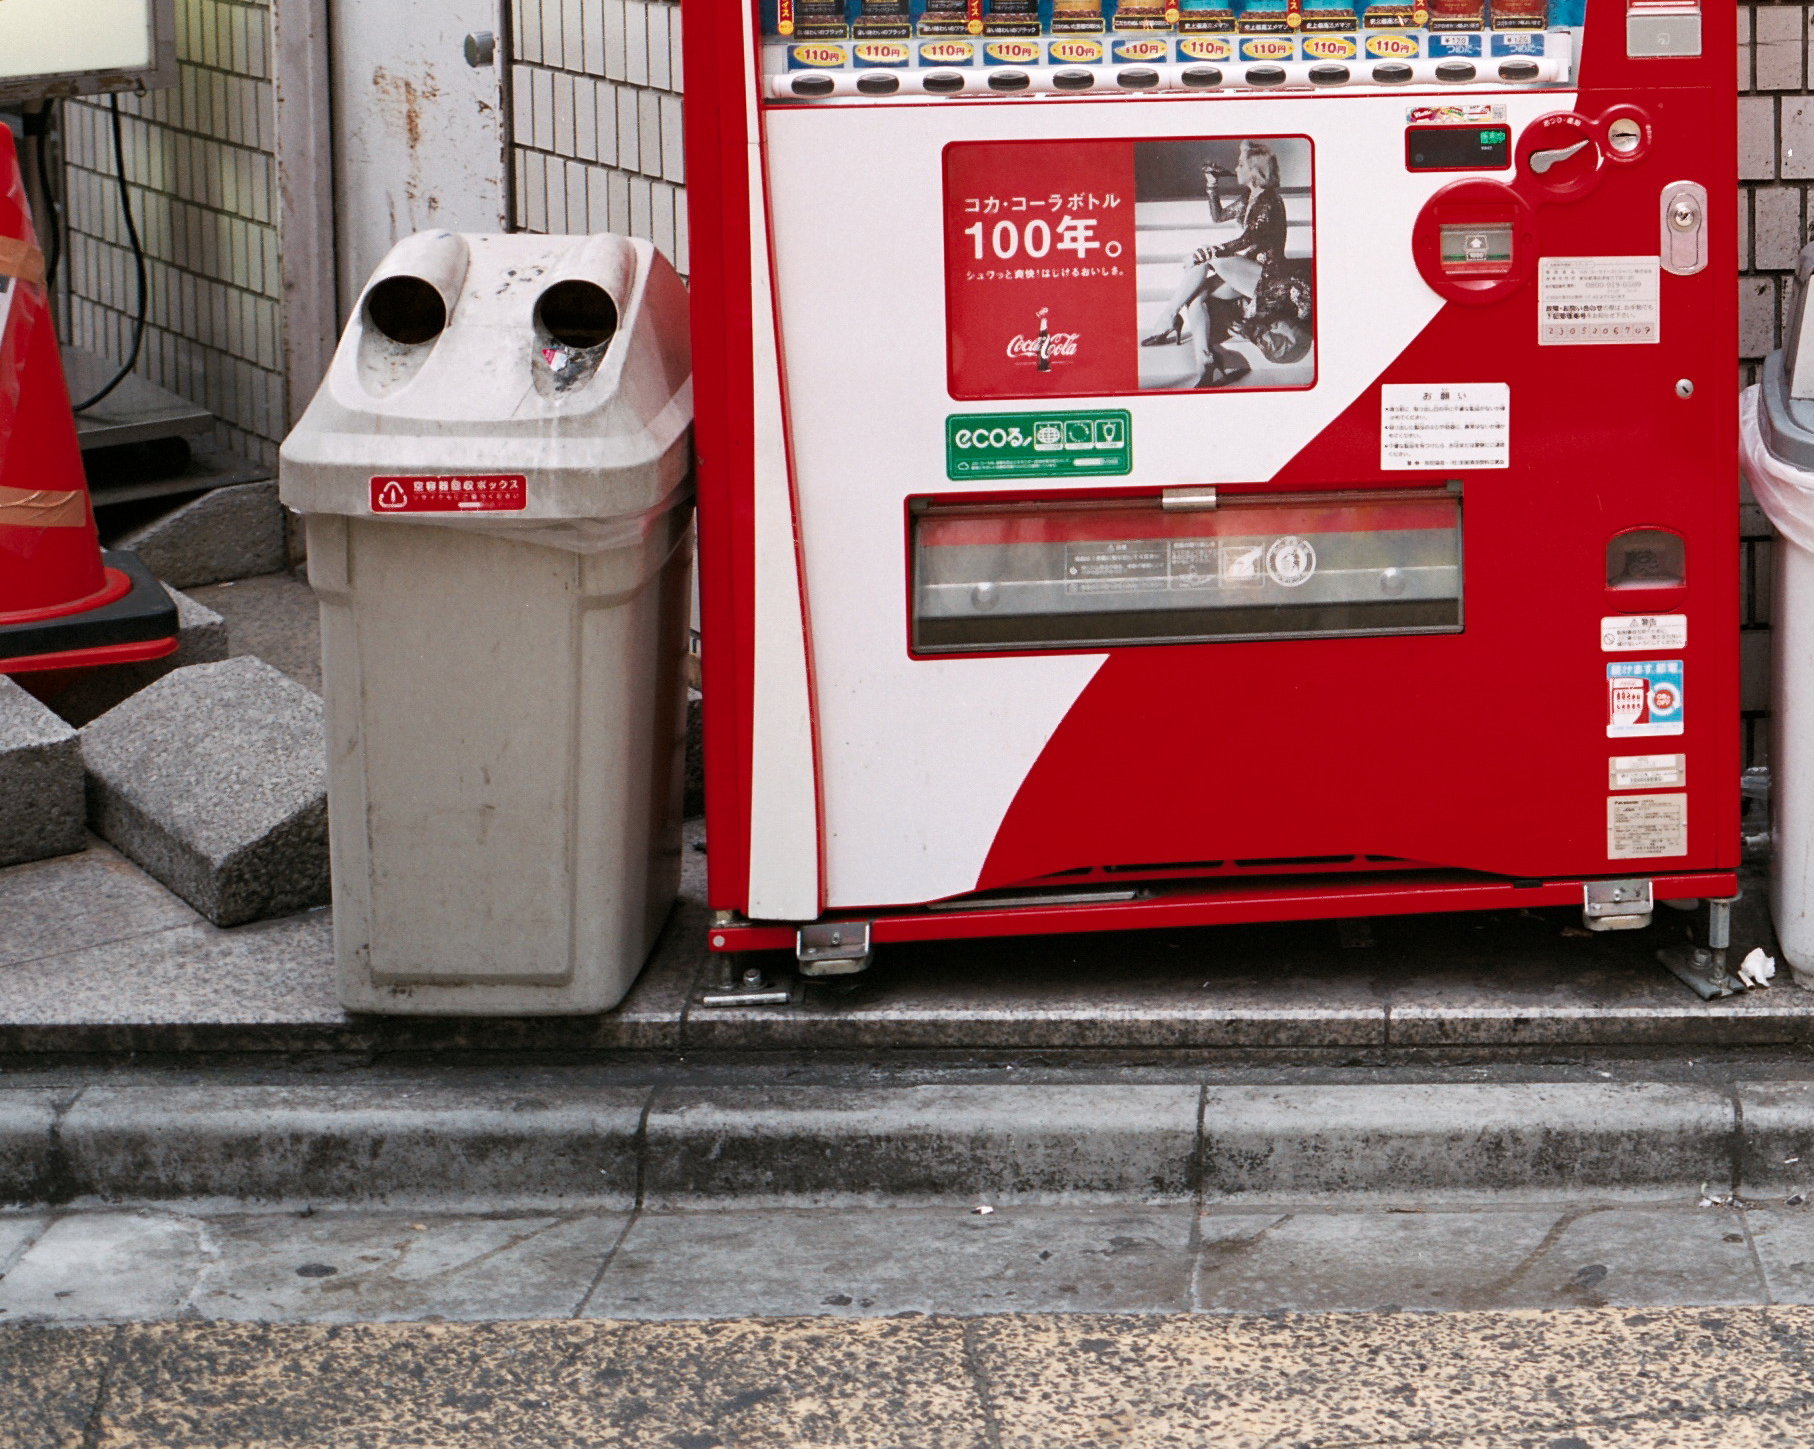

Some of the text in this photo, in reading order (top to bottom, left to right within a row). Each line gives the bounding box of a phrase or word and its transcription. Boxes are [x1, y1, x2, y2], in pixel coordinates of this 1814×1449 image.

[865, 45, 900, 58] 110円
[931, 45, 965, 56] 110円
[998, 45, 1031, 57] 110円
[1061, 45, 1095, 56] 110円
[1190, 41, 1224, 54] 110円
[1252, 43, 1286, 54] 110円
[1313, 41, 1347, 54] 110円
[805, 48, 839, 61] 110円
[964, 193, 1121, 214] コカ・コーラボトル
[963, 215, 1122, 260] 100年。
